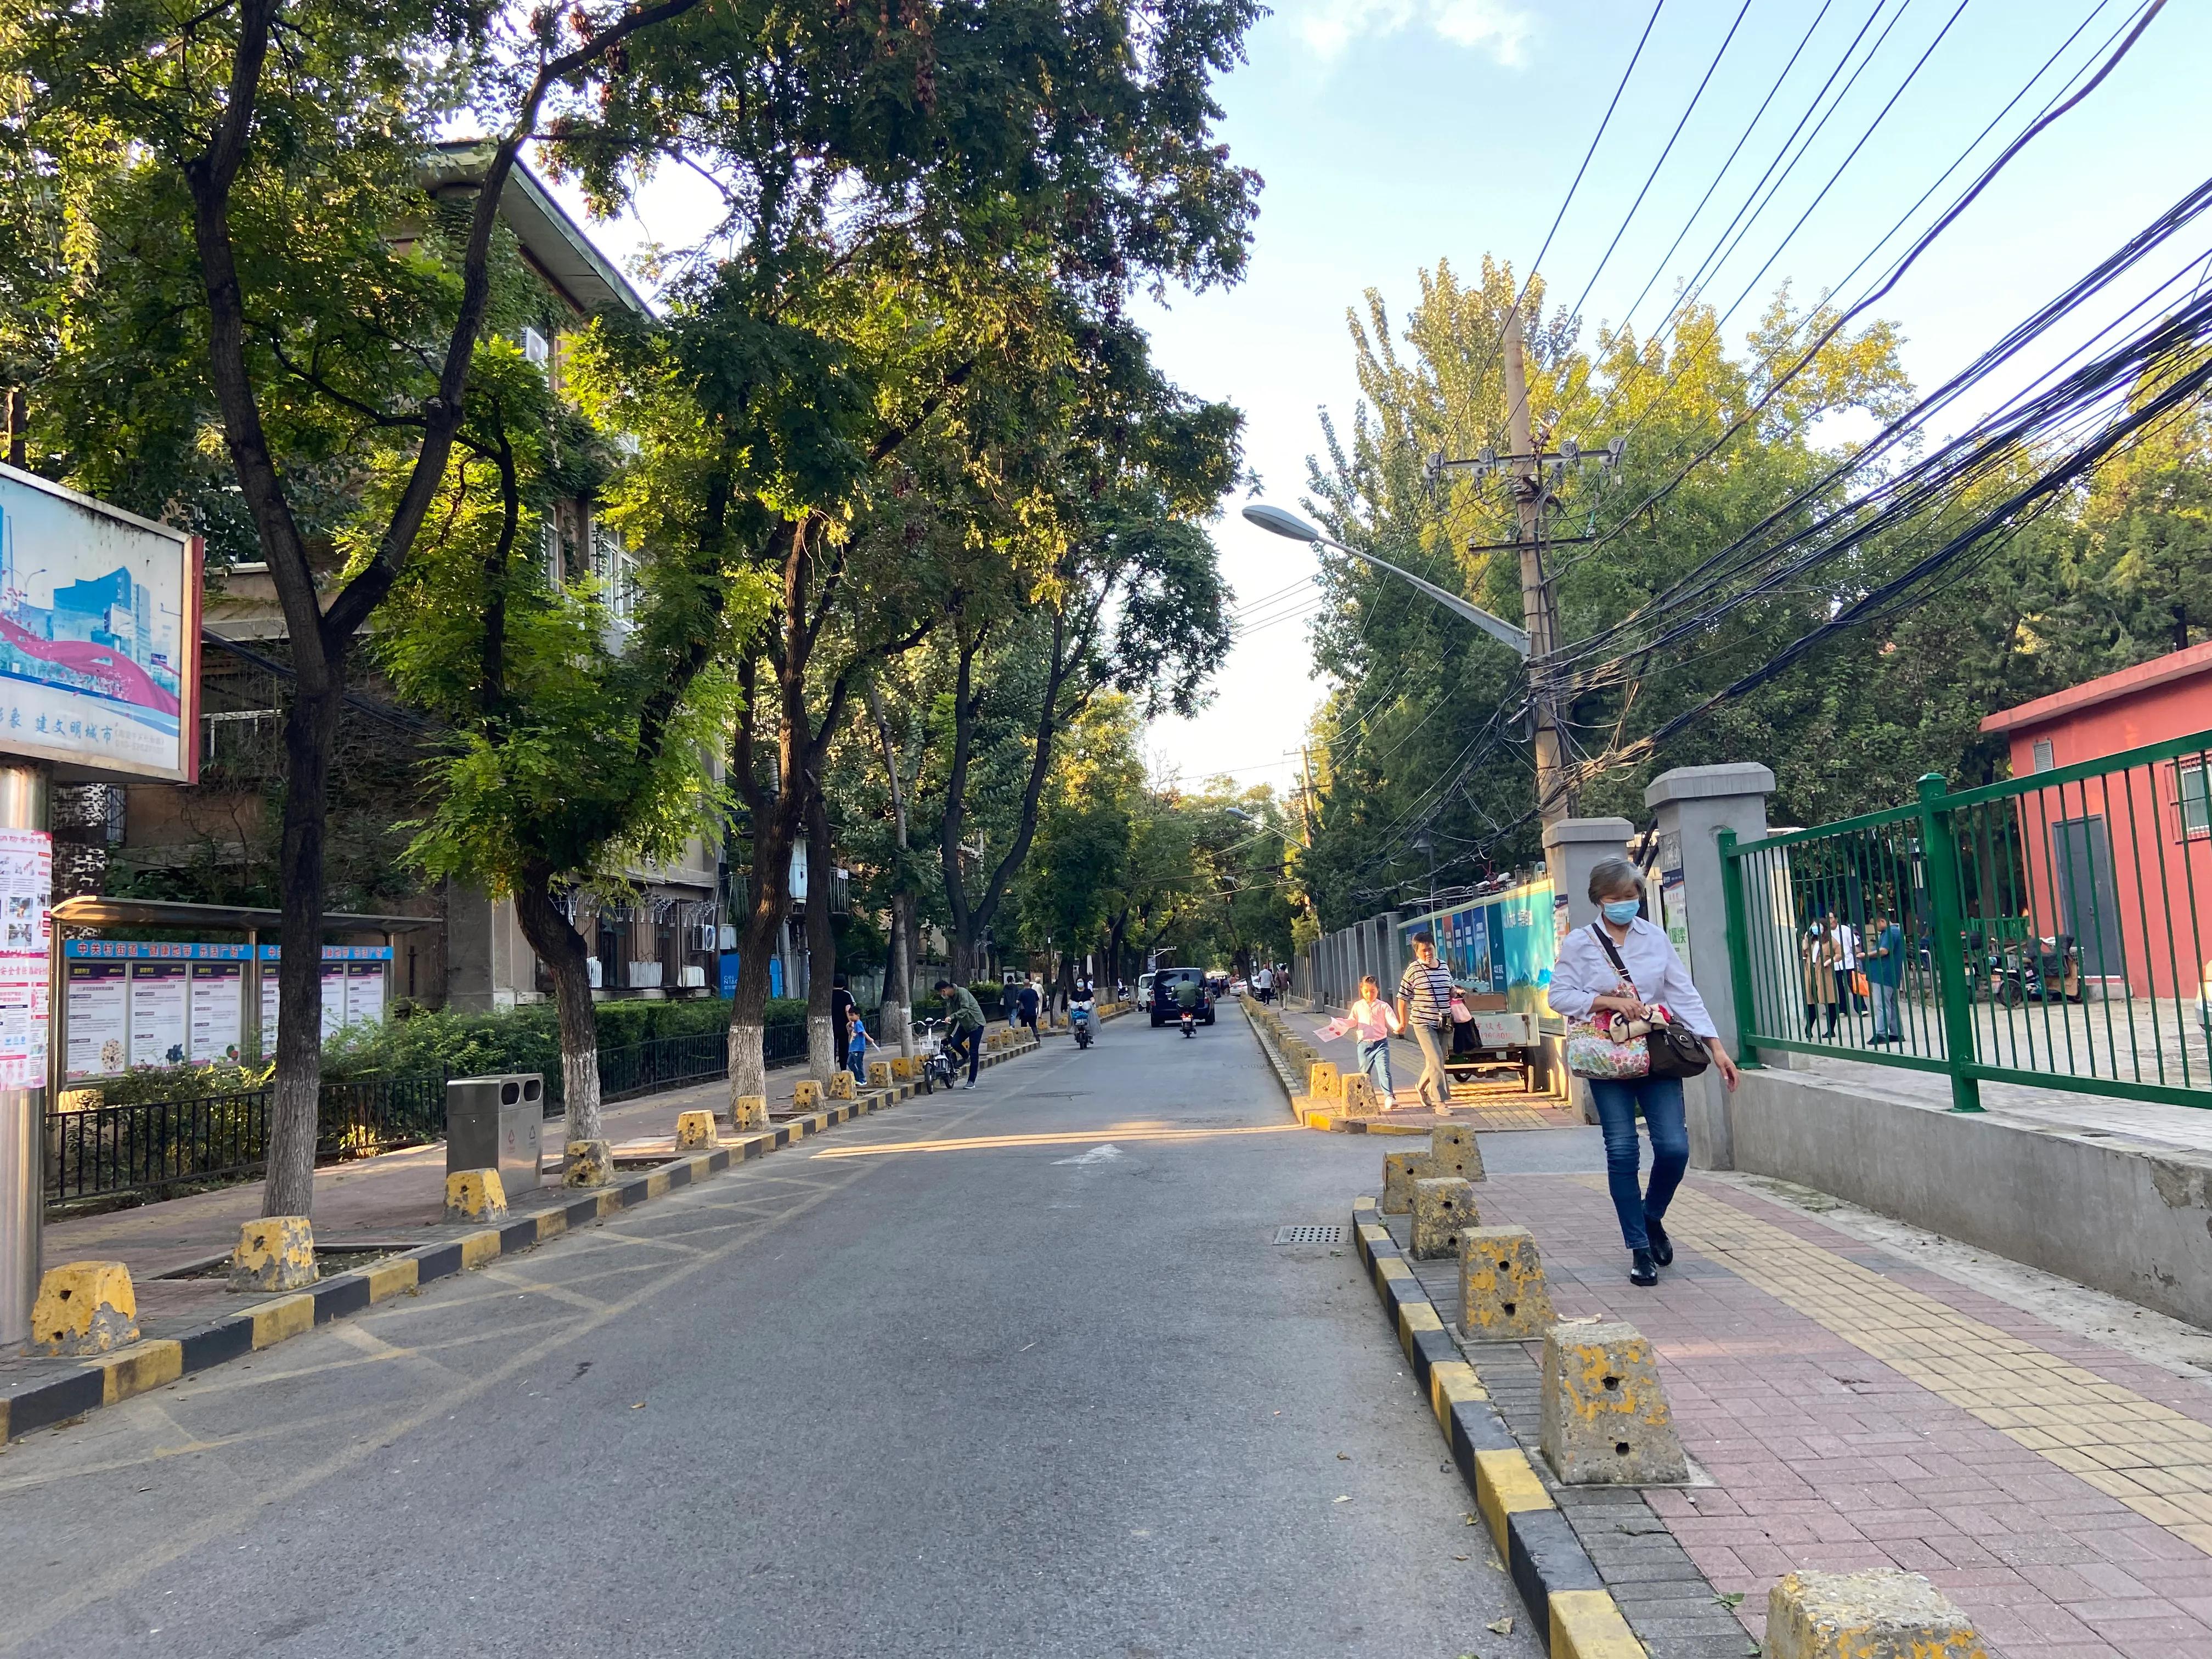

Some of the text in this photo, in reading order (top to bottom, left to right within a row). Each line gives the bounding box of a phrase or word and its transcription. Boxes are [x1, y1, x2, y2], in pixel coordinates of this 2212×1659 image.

[35, 713, 113, 744] 建文明城市
